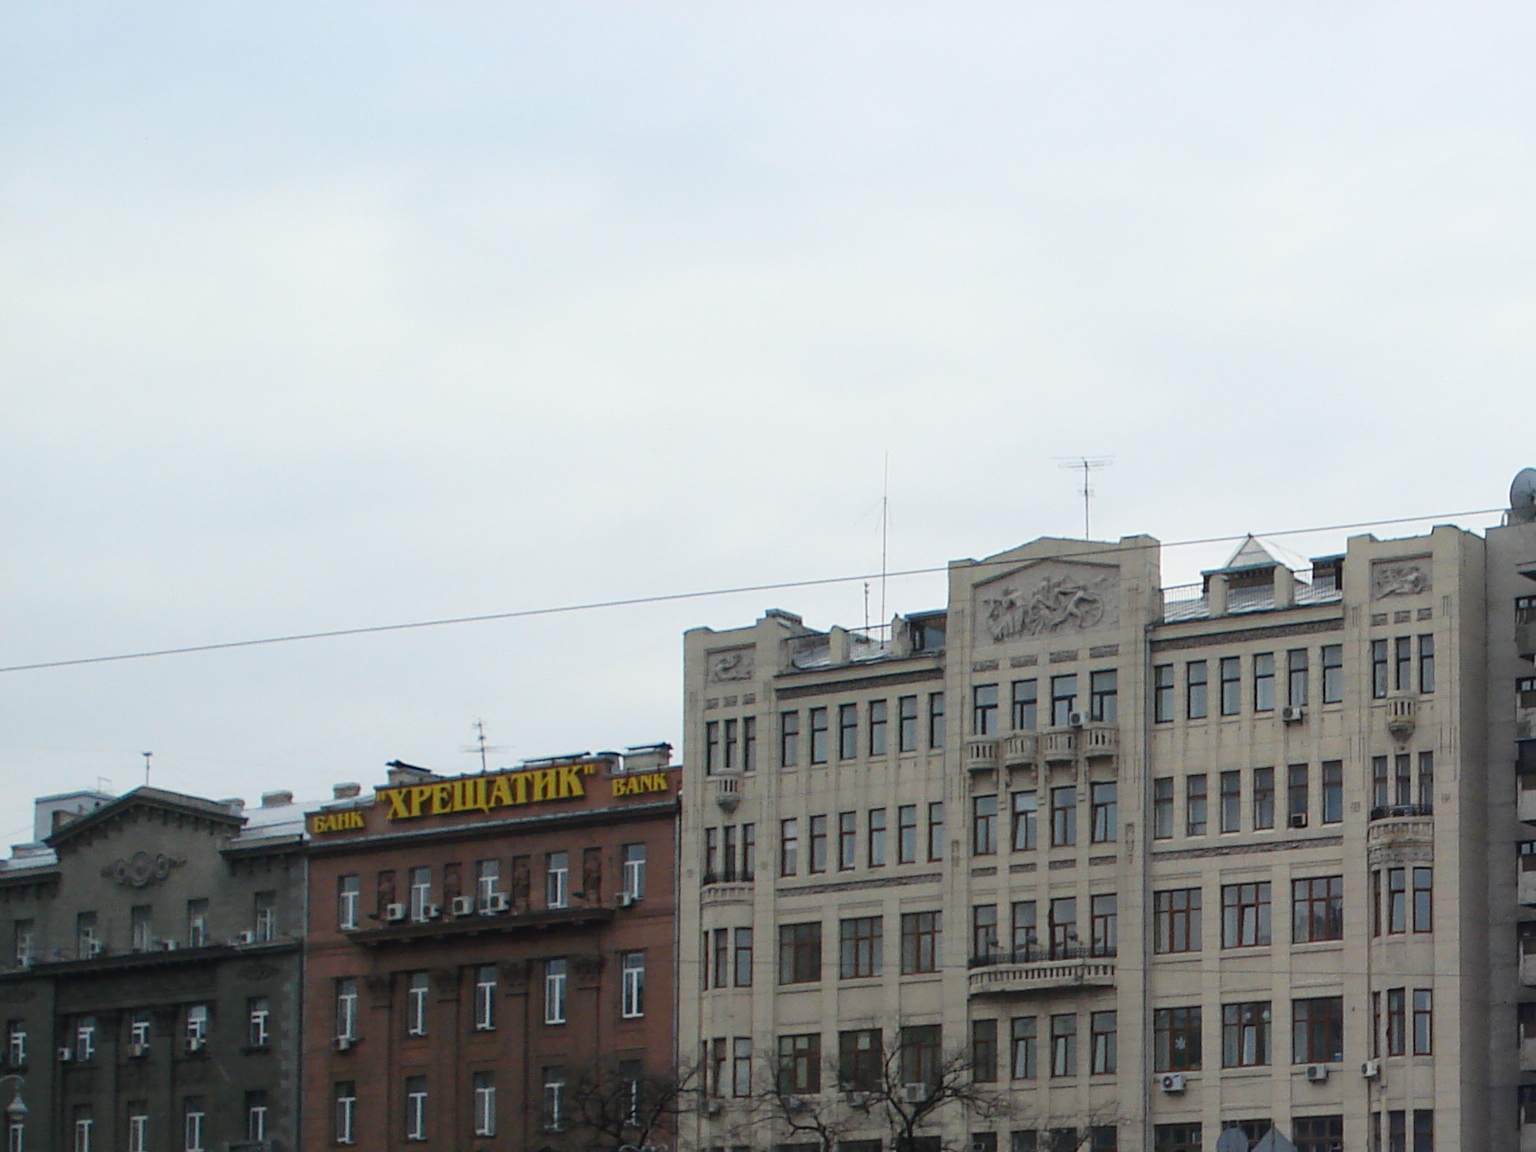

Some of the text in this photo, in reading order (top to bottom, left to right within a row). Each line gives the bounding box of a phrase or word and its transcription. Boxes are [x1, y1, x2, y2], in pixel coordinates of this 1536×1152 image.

[314, 764, 595, 833] БАНК "ХРЕЩАТИК"
[612, 773, 668, 796] BANK
